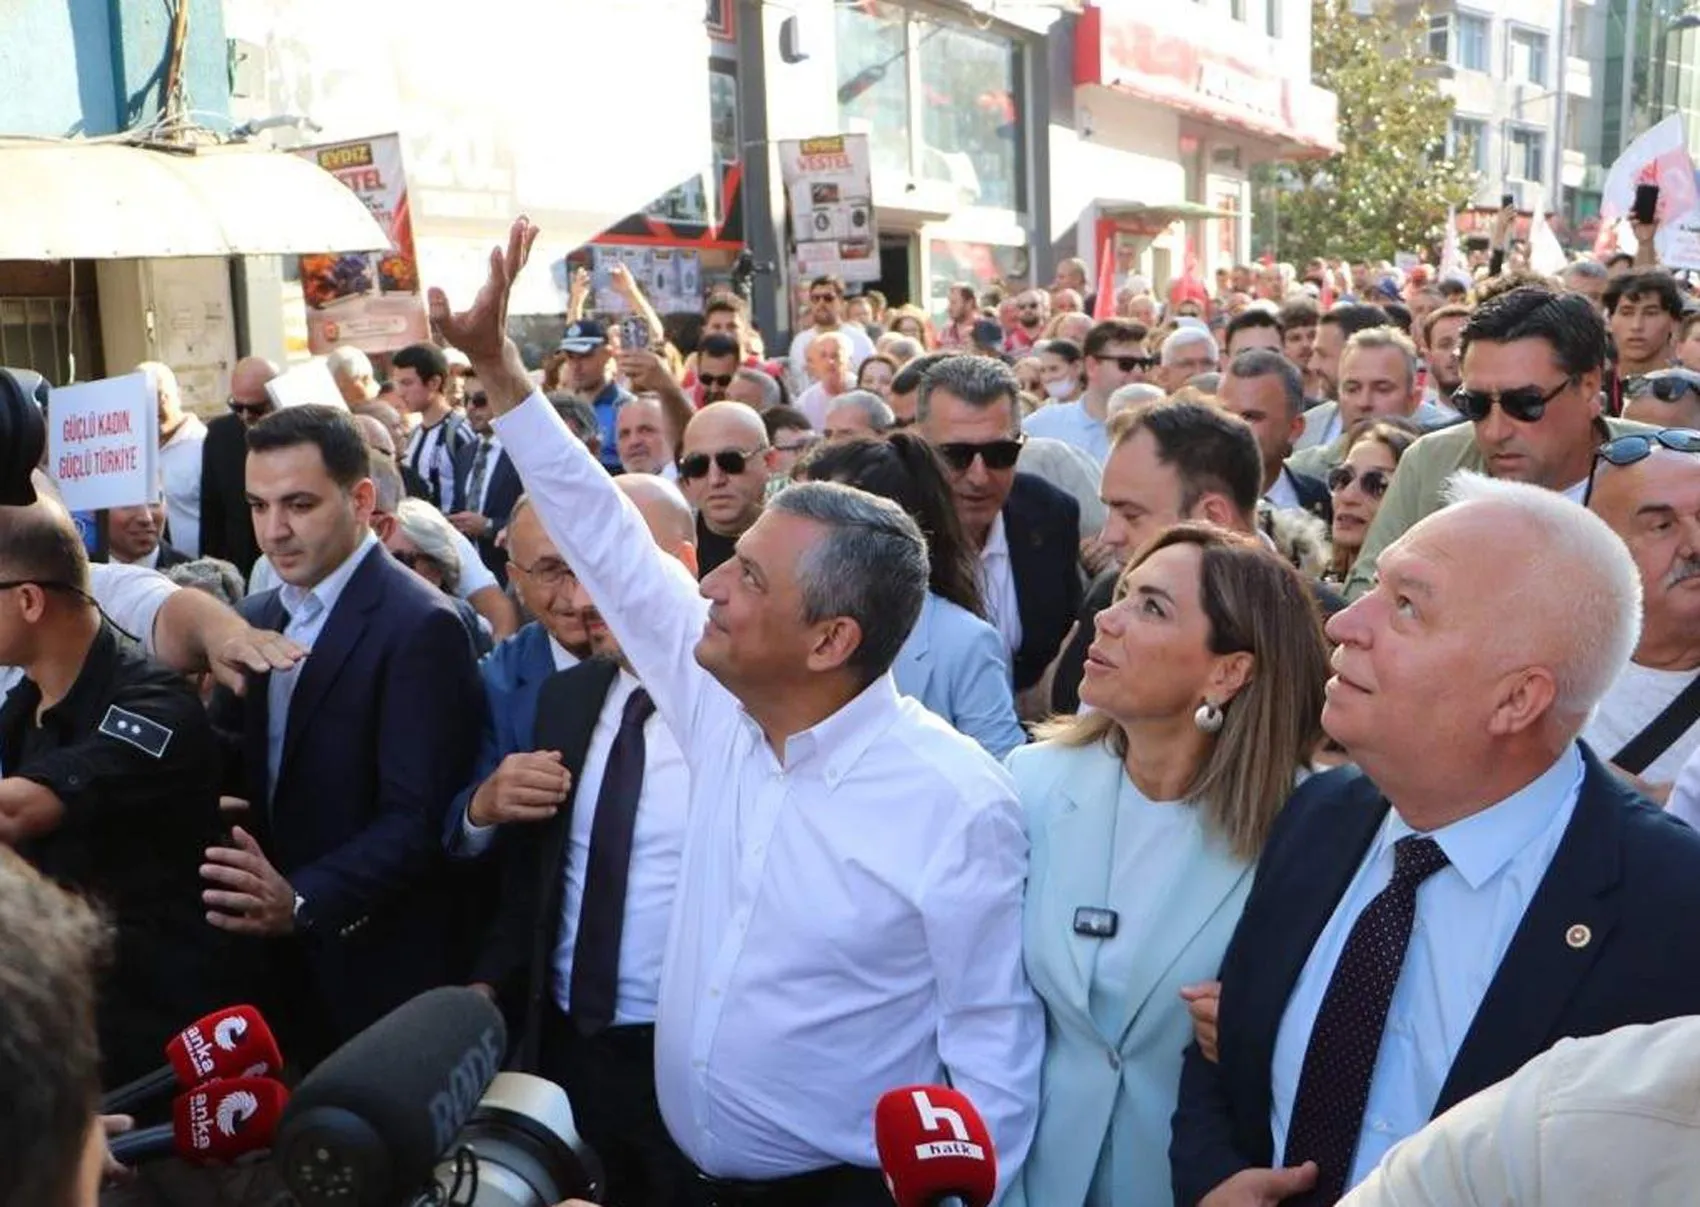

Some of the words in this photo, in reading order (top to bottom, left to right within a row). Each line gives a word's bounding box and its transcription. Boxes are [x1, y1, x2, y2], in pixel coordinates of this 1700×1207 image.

[797, 154, 852, 170] VESTEL
[63, 411, 96, 443] GÜÇLÜ
[58, 449, 92, 481] GÜÇLÜ
[94, 445, 137, 475] TÜRKİYE
[186, 1026, 215, 1073] anka
[195, 1093, 214, 1149] anka
[929, 1144, 971, 1155] halk
